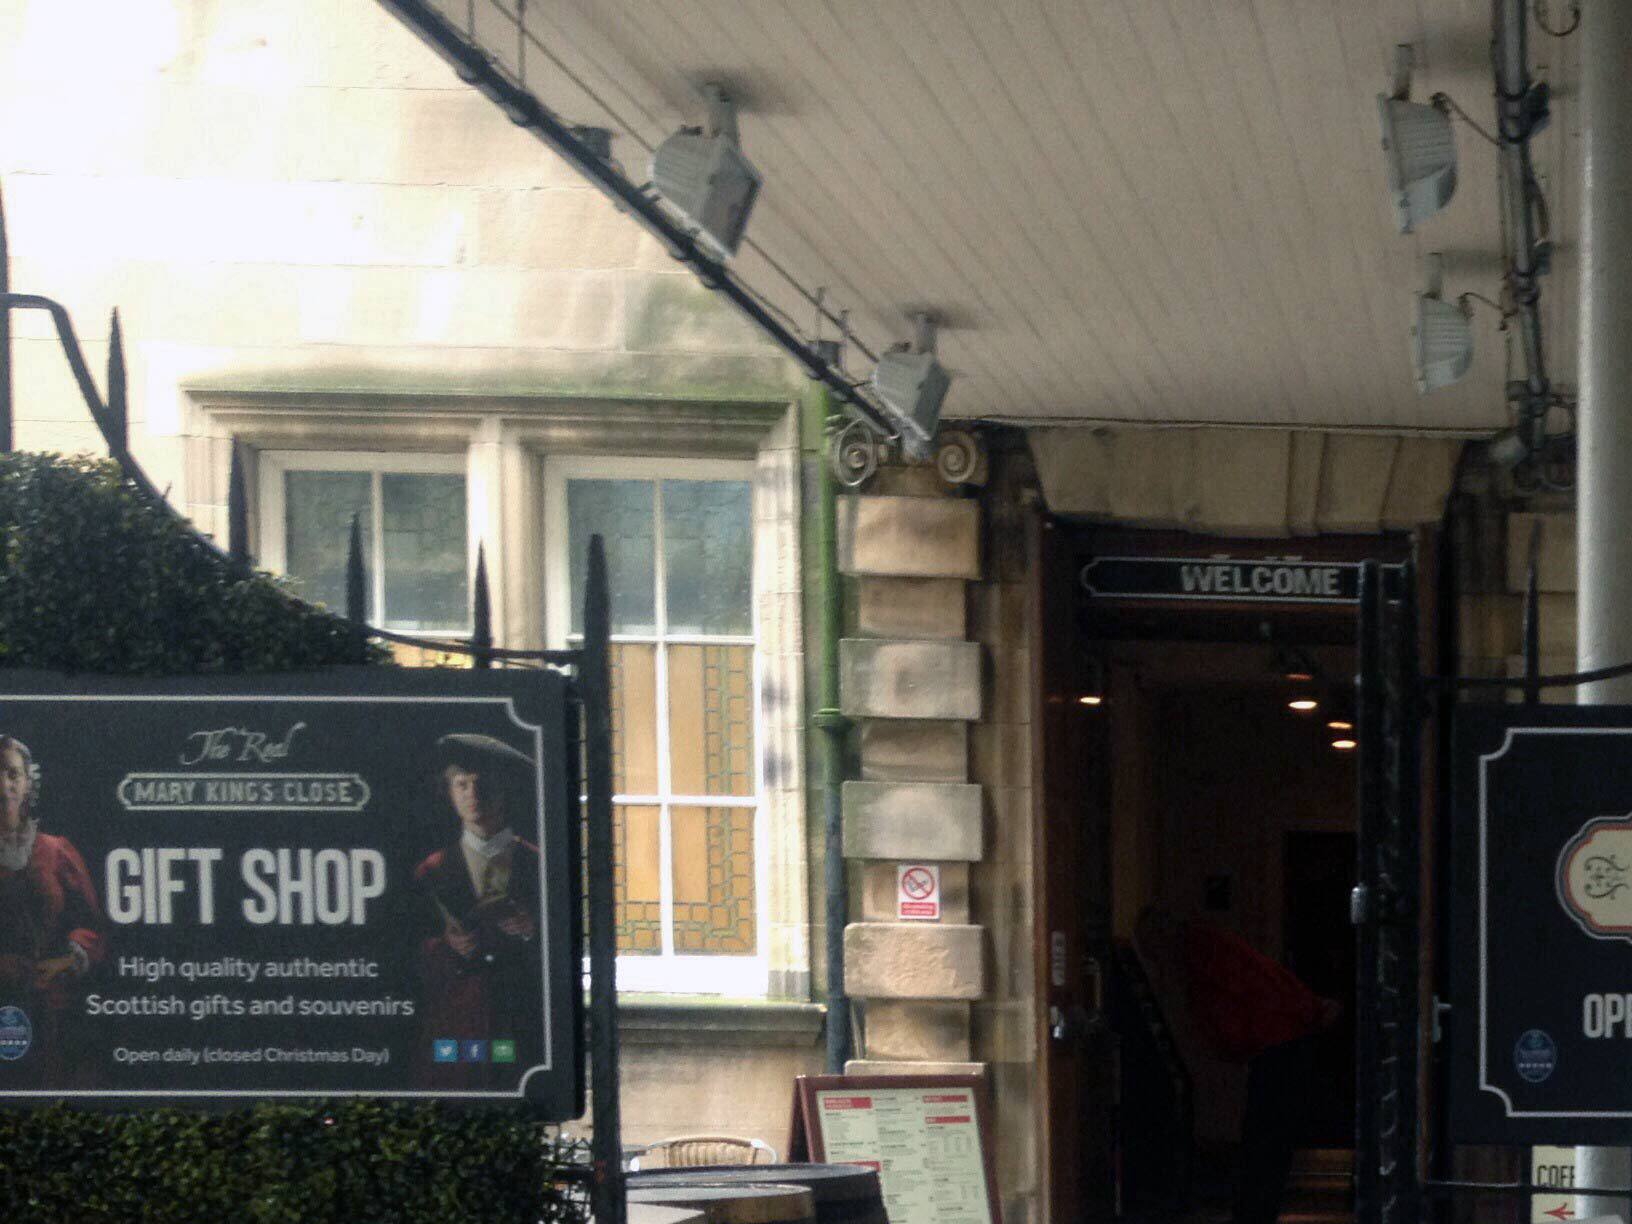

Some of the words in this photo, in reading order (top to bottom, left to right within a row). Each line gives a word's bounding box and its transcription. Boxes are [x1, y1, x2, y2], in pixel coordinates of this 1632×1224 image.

[1179, 564, 1342, 596] WELCOME
[179, 727, 237, 766] The
[133, 781, 196, 804] MARY
[282, 781, 354, 803] CLOSE
[105, 847, 223, 926] GIFT
[240, 847, 387, 926] SHOP
[118, 956, 175, 983] High
[178, 956, 260, 983] quality
[264, 957, 379, 979] authentic
[85, 993, 186, 1016] Scottish
[189, 993, 246, 1021] gifts
[249, 995, 294, 1016] and
[299, 995, 415, 1017] souvenirs
[112, 1047, 161, 1066] Open
[162, 1046, 201, 1066] daily
[203, 1047, 262, 1065] (closed
[264, 1046, 350, 1063] Christmas
[351, 1047, 390, 1066] Day)
